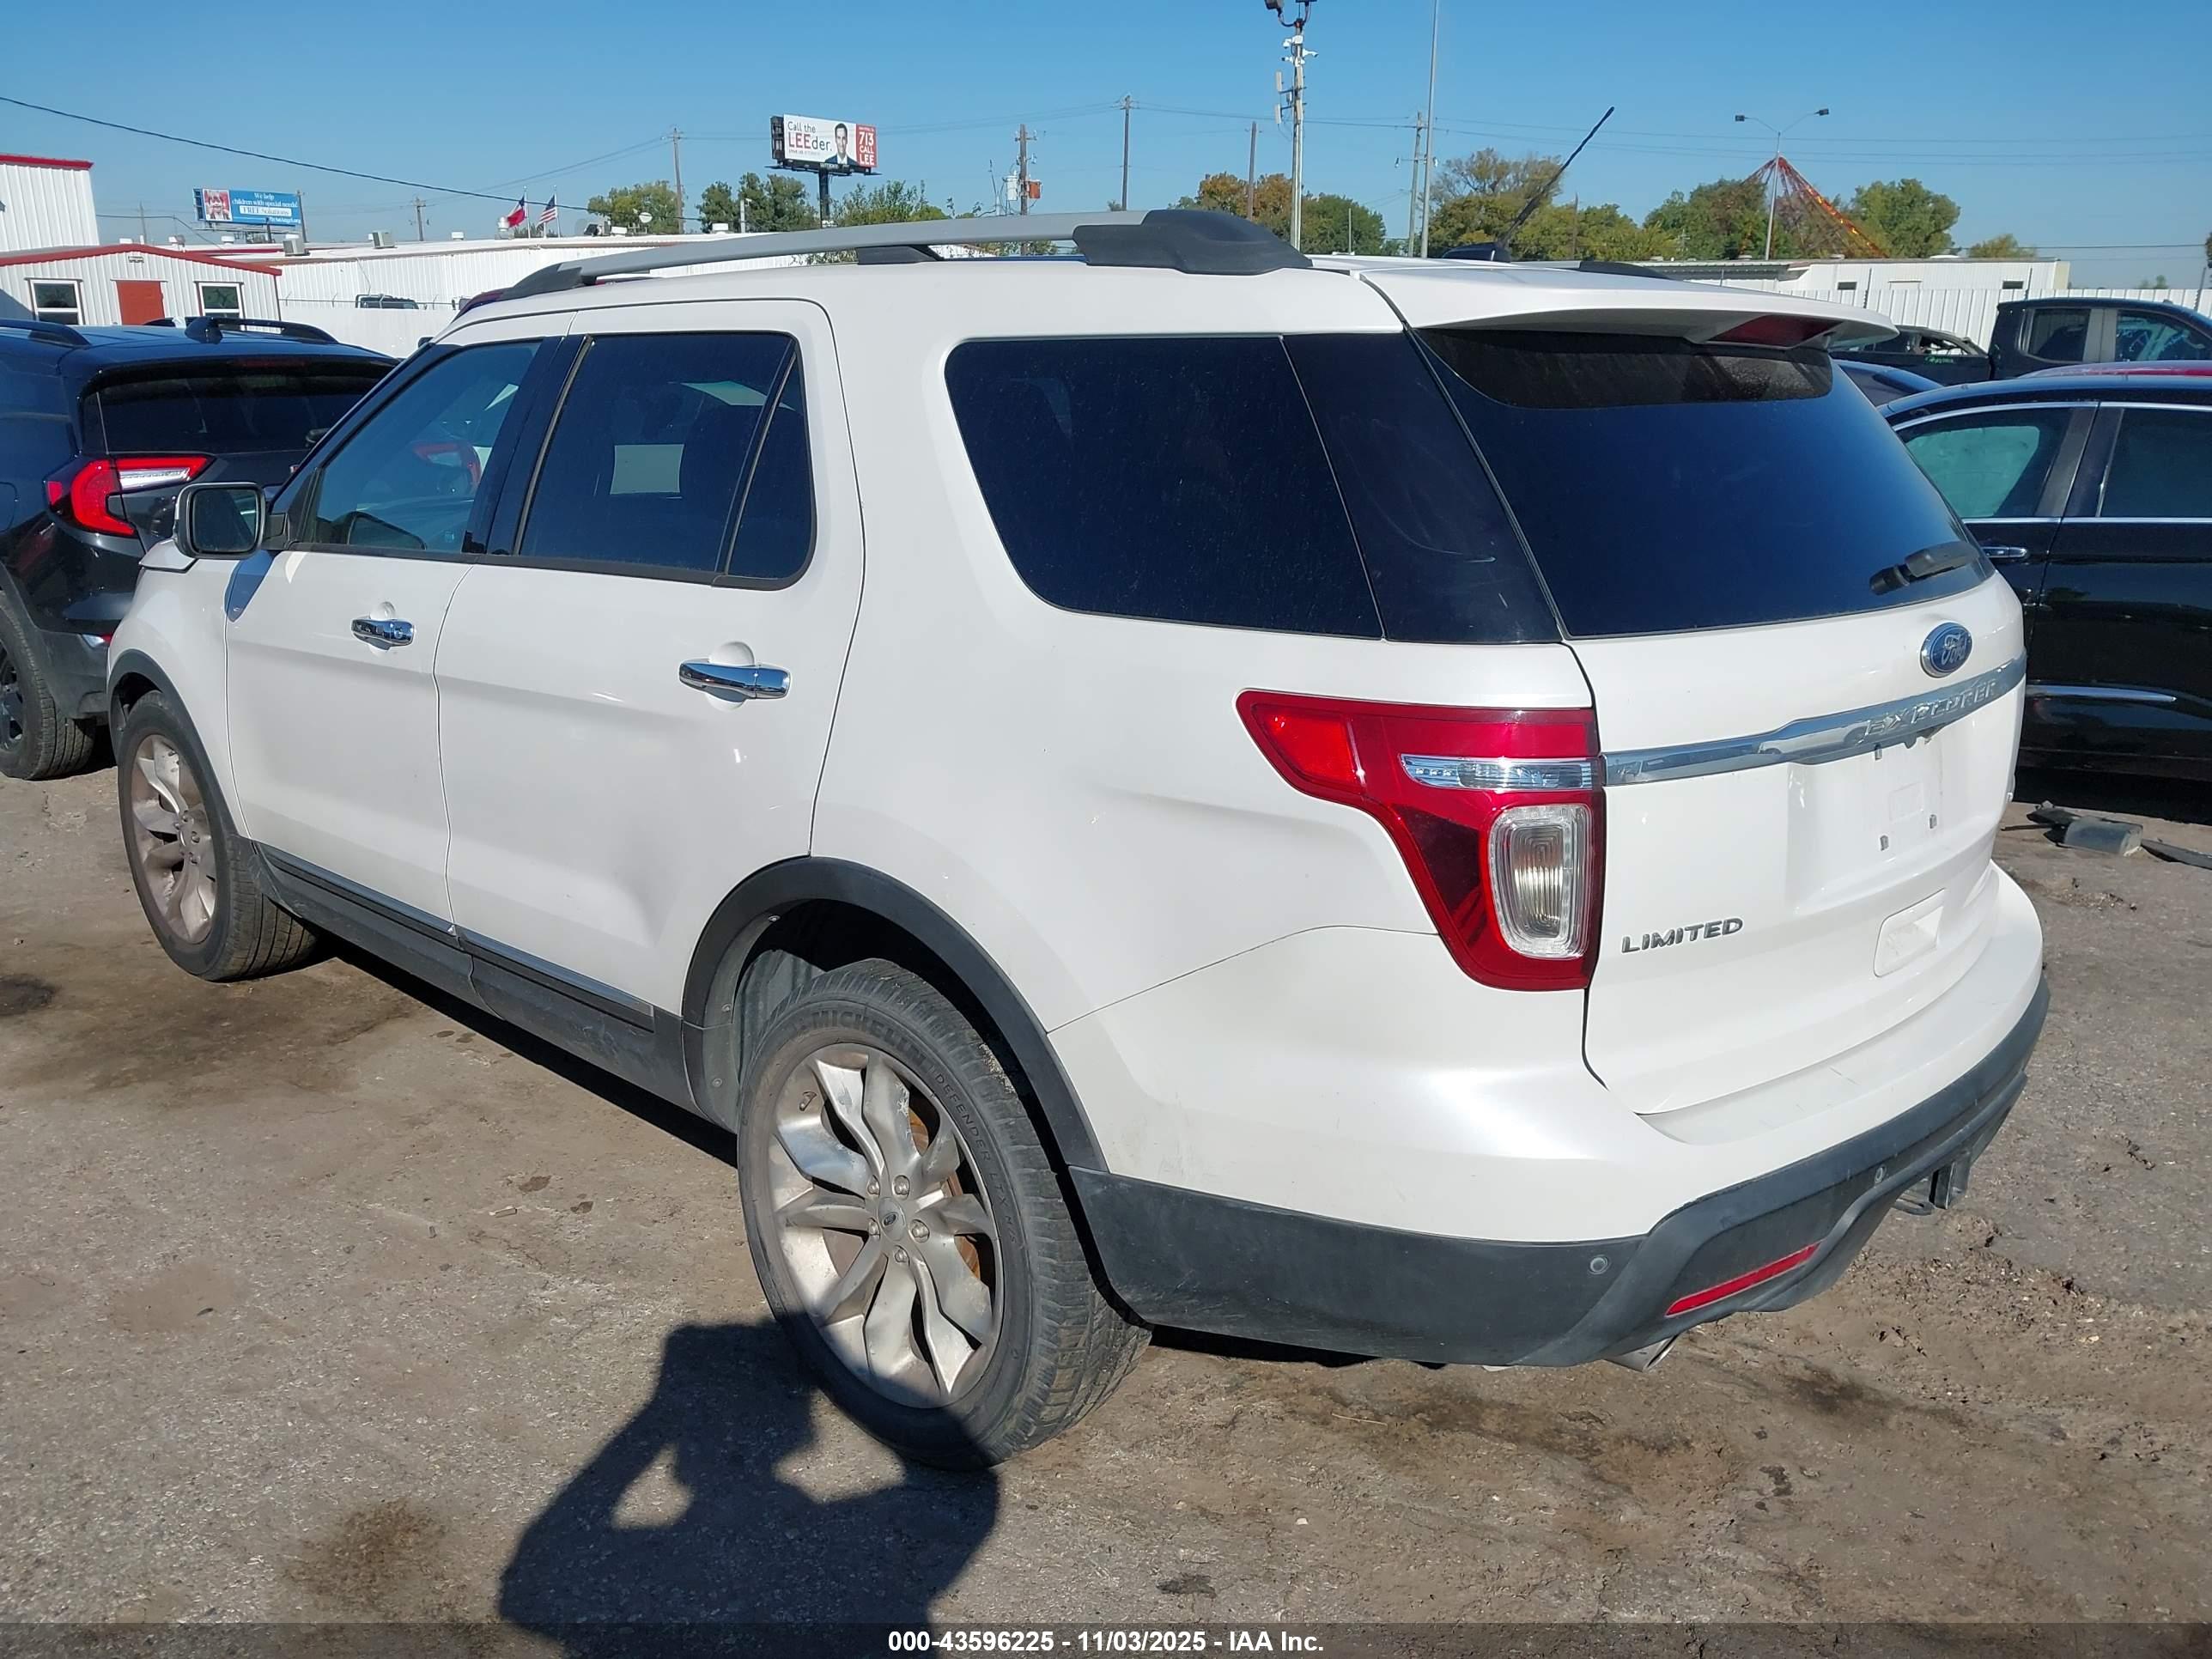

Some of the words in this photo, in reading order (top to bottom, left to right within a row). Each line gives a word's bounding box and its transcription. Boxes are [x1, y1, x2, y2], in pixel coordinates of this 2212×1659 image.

[787, 121, 802, 131] Call
[804, 125, 816, 133] the
[788, 132, 833, 151] LEEder.
[859, 131, 874, 146] 713
[860, 145, 874, 155] CALL
[860, 154, 875, 166] LEE
[1942, 634, 1968, 665] Ford
[1621, 917, 1744, 953] LIMITED
[934, 1073, 991, 1162] DEFENDER
